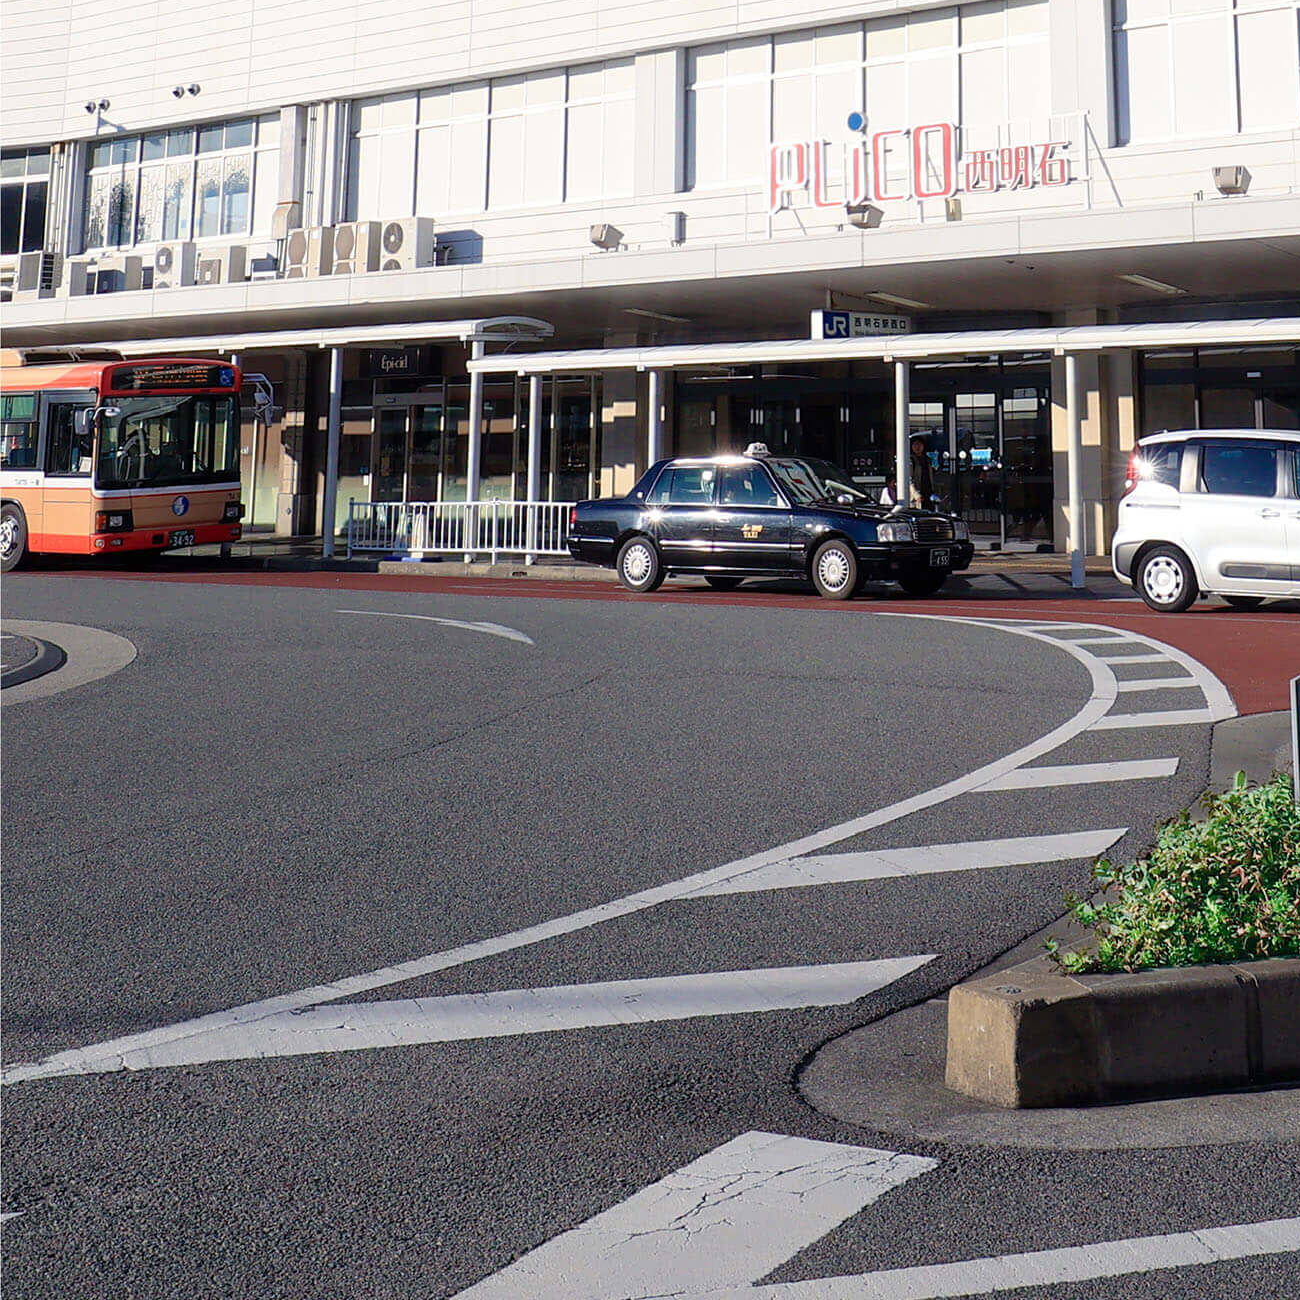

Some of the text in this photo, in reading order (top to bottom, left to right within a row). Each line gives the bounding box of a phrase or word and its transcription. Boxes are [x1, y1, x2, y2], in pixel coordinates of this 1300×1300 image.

[963, 141, 1073, 194] 西明石
[825, 316, 847, 336] JR
